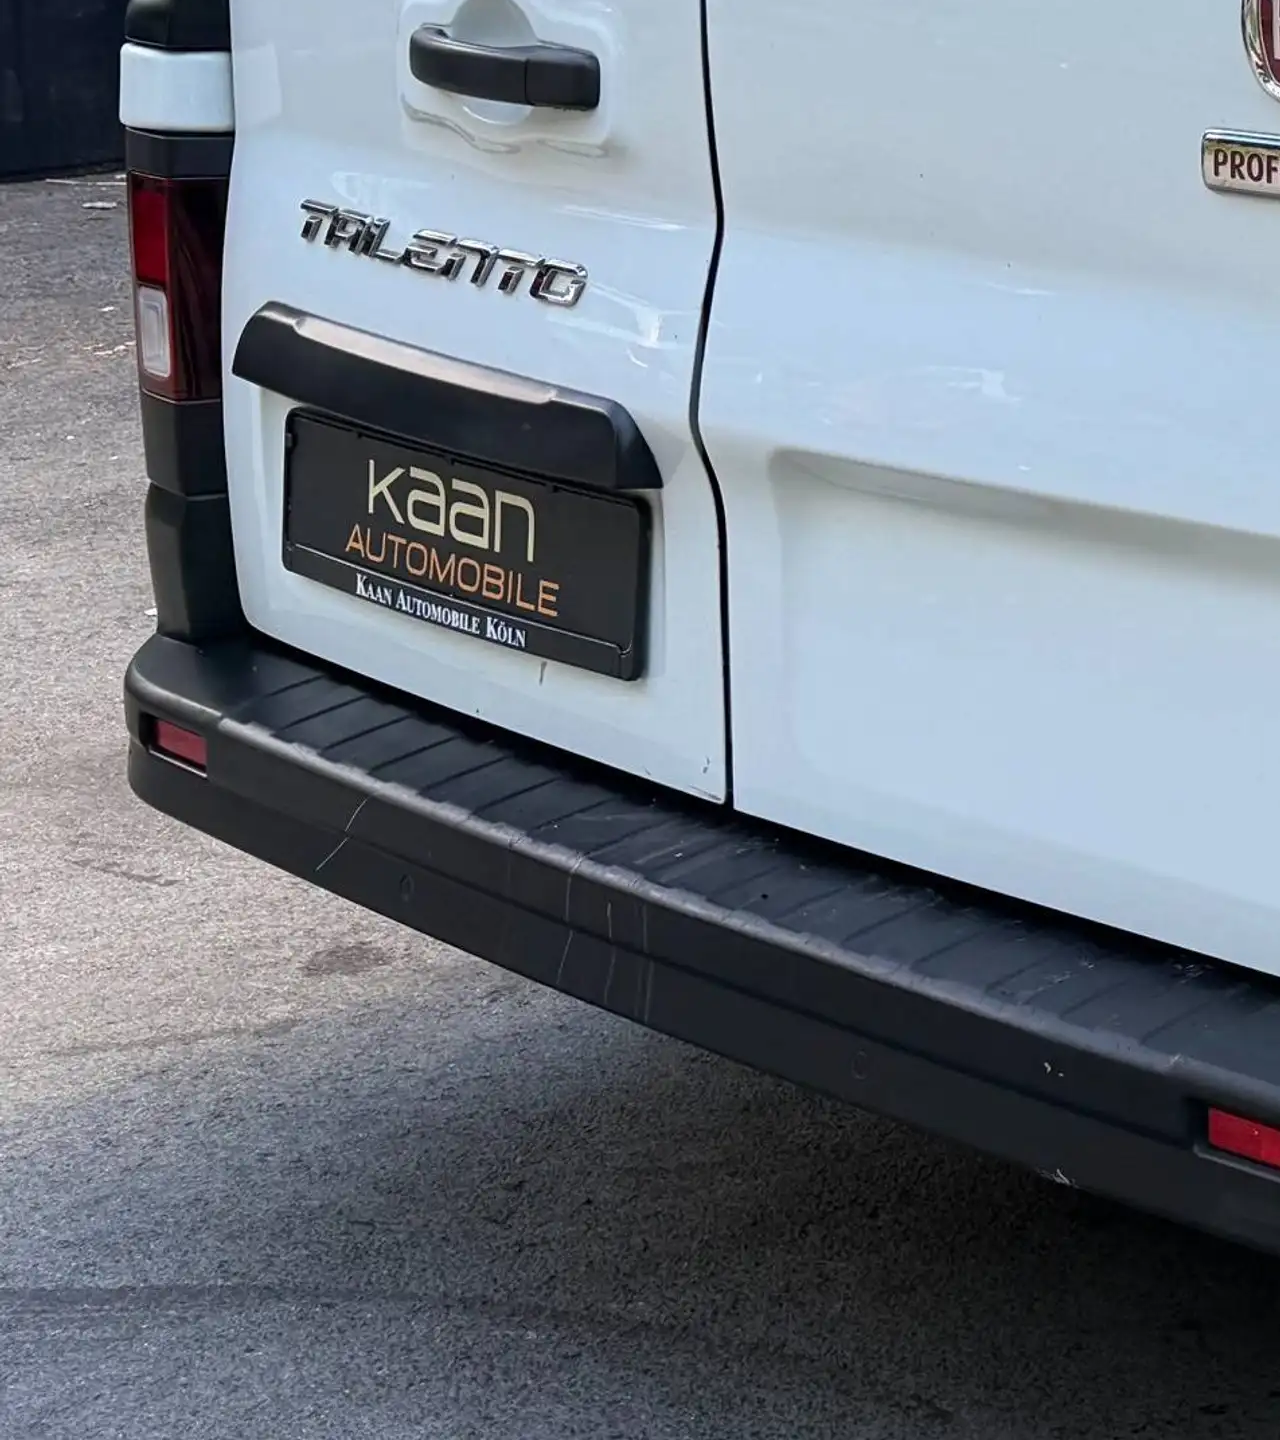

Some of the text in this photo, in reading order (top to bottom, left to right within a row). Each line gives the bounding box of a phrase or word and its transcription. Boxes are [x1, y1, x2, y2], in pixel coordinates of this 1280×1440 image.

[301, 198, 589, 307] TALENTO
[345, 524, 560, 618] AUTOMOBILE
[356, 573, 527, 648] KAAN AUTOMOBILE KÖLN
